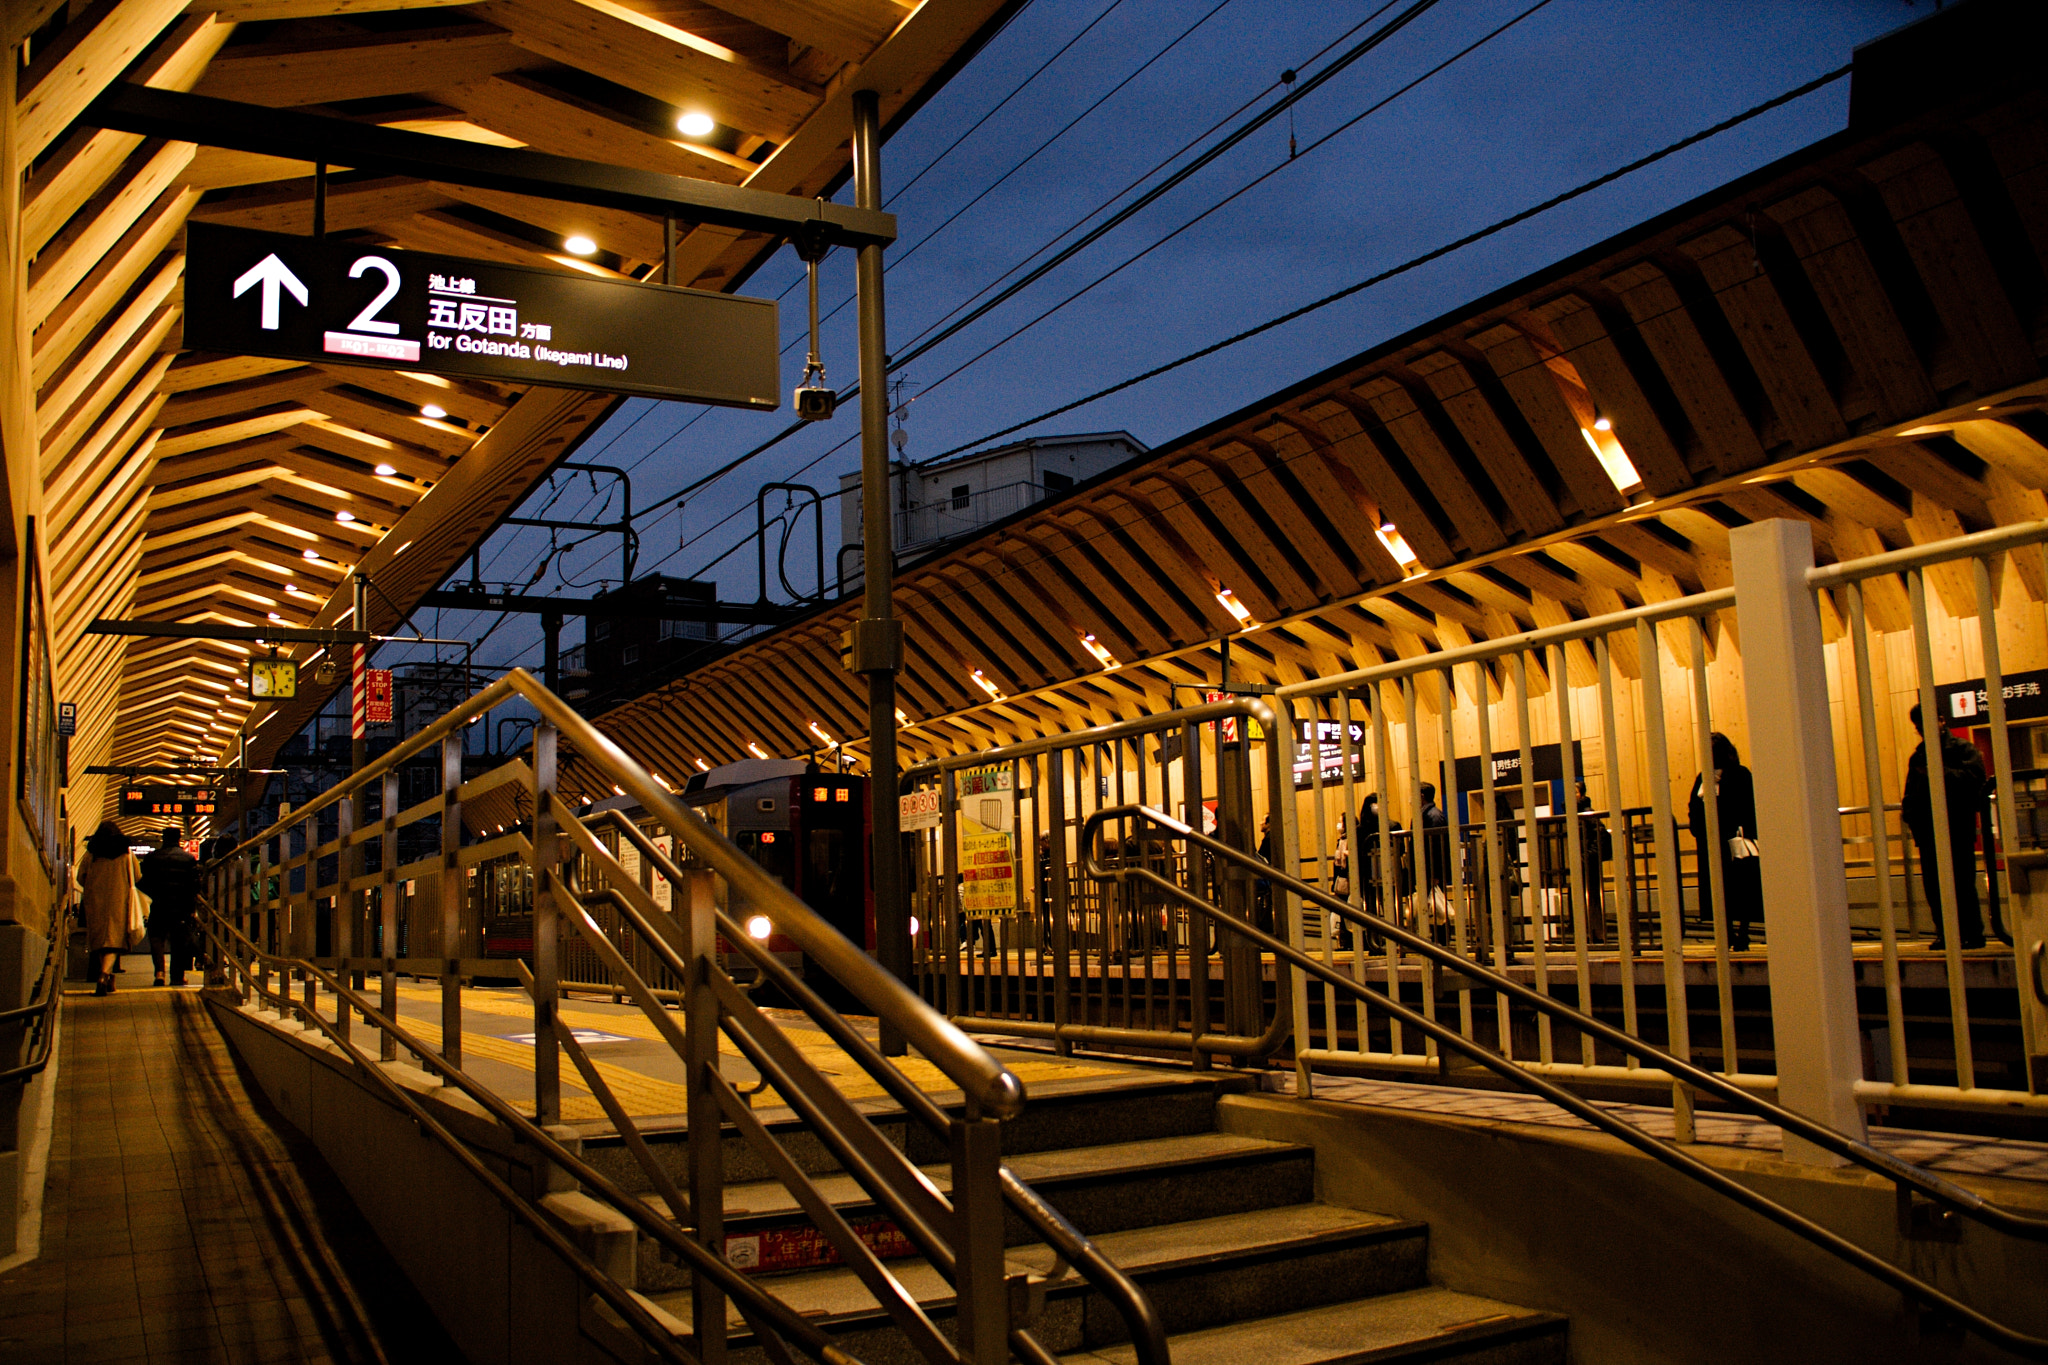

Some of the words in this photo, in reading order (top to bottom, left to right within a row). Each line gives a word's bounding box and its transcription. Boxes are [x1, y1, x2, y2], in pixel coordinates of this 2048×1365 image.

[347, 255, 401, 335] 2
[428, 274, 476, 295] 池上線
[427, 299, 517, 337] 五反田
[520, 322, 552, 341] 方面
[427, 331, 453, 350] for
[456, 334, 530, 359] Gotanda
[534, 340, 593, 366] (Ikegami
[595, 352, 628, 371] Line)
[1976, 682, 2041, 704] 女お手洗
[209, 790, 217, 801] 2
